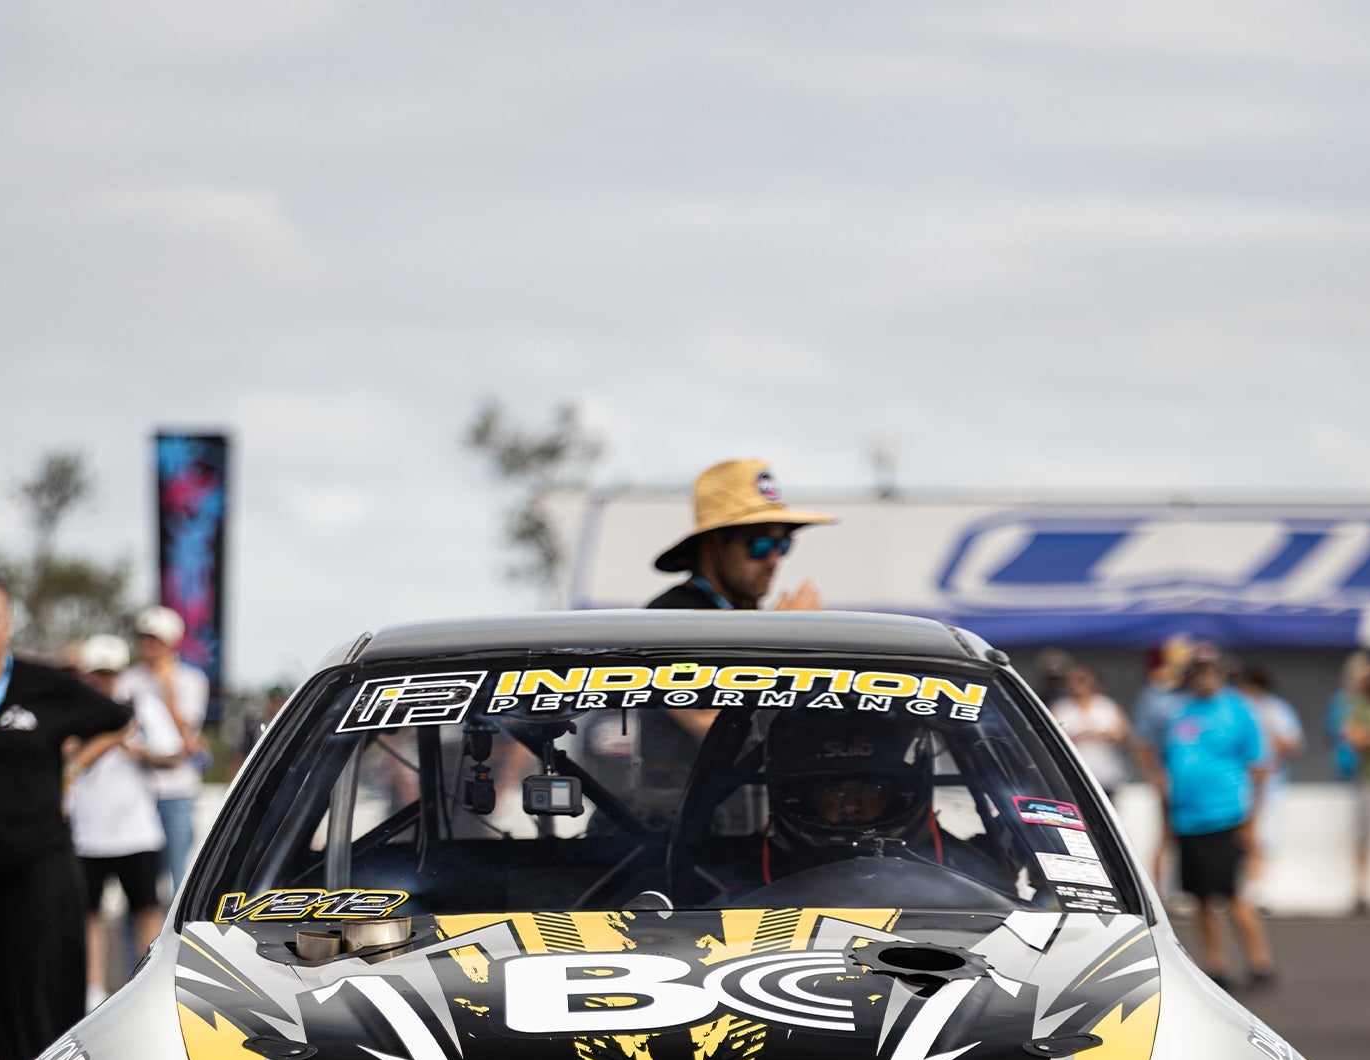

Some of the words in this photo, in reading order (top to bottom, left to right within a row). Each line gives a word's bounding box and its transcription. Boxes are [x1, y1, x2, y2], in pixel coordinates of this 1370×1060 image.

[493, 666, 988, 707] INDUCTION
[486, 689, 981, 722] PERFORMANCE
[215, 889, 408, 923] V212
